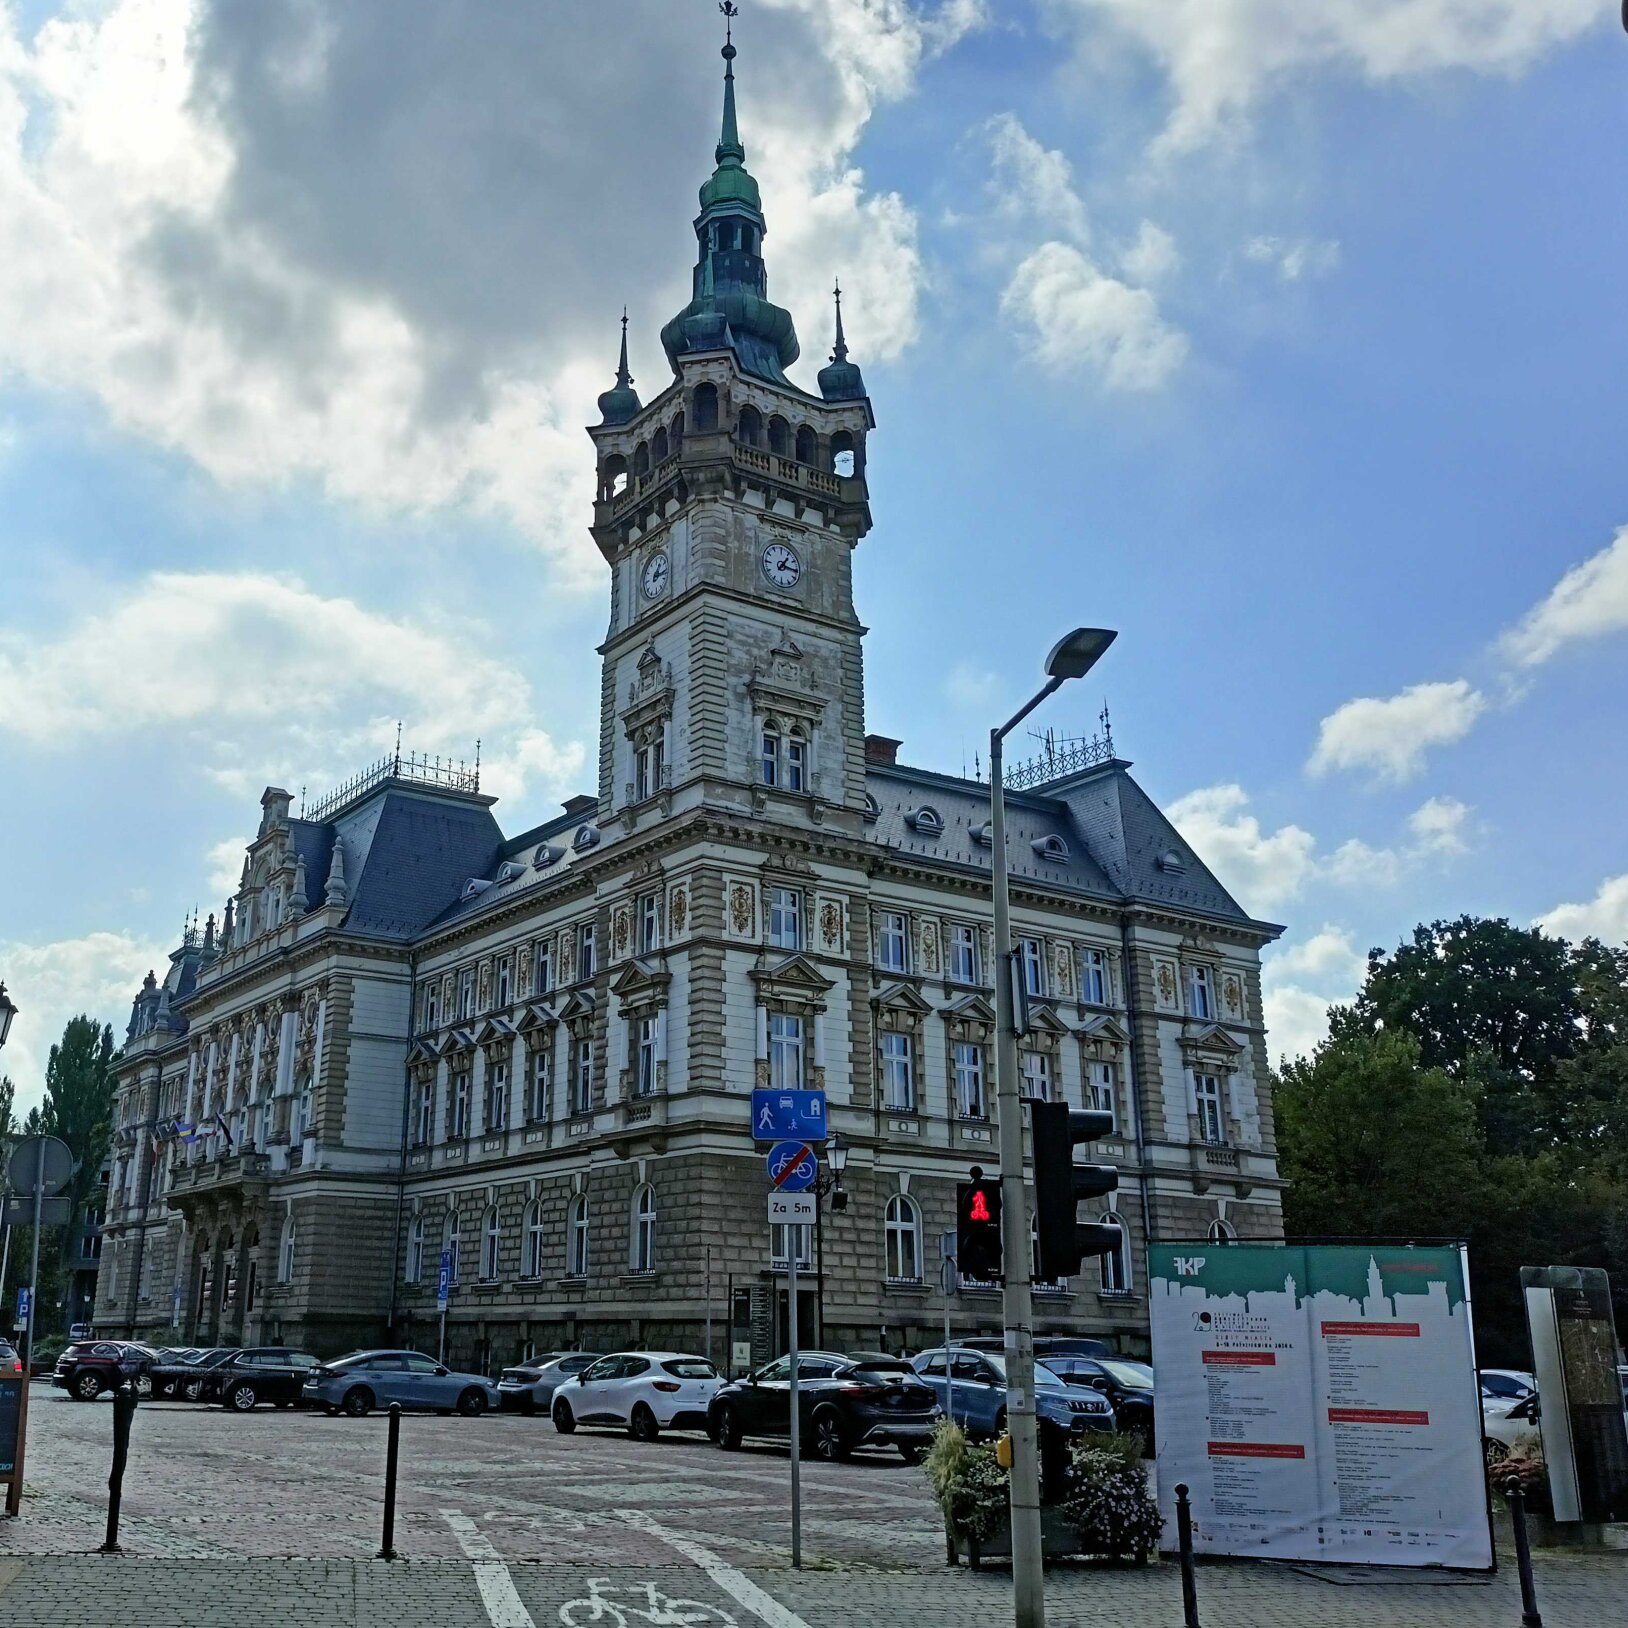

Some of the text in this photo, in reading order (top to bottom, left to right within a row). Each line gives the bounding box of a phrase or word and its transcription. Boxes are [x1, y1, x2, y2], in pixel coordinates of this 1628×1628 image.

[773, 1202, 811, 1214] Za 5m
[1173, 1257, 1206, 1276] FKP
[440, 1271, 447, 1291] P
[20, 1304, 29, 1316] P
